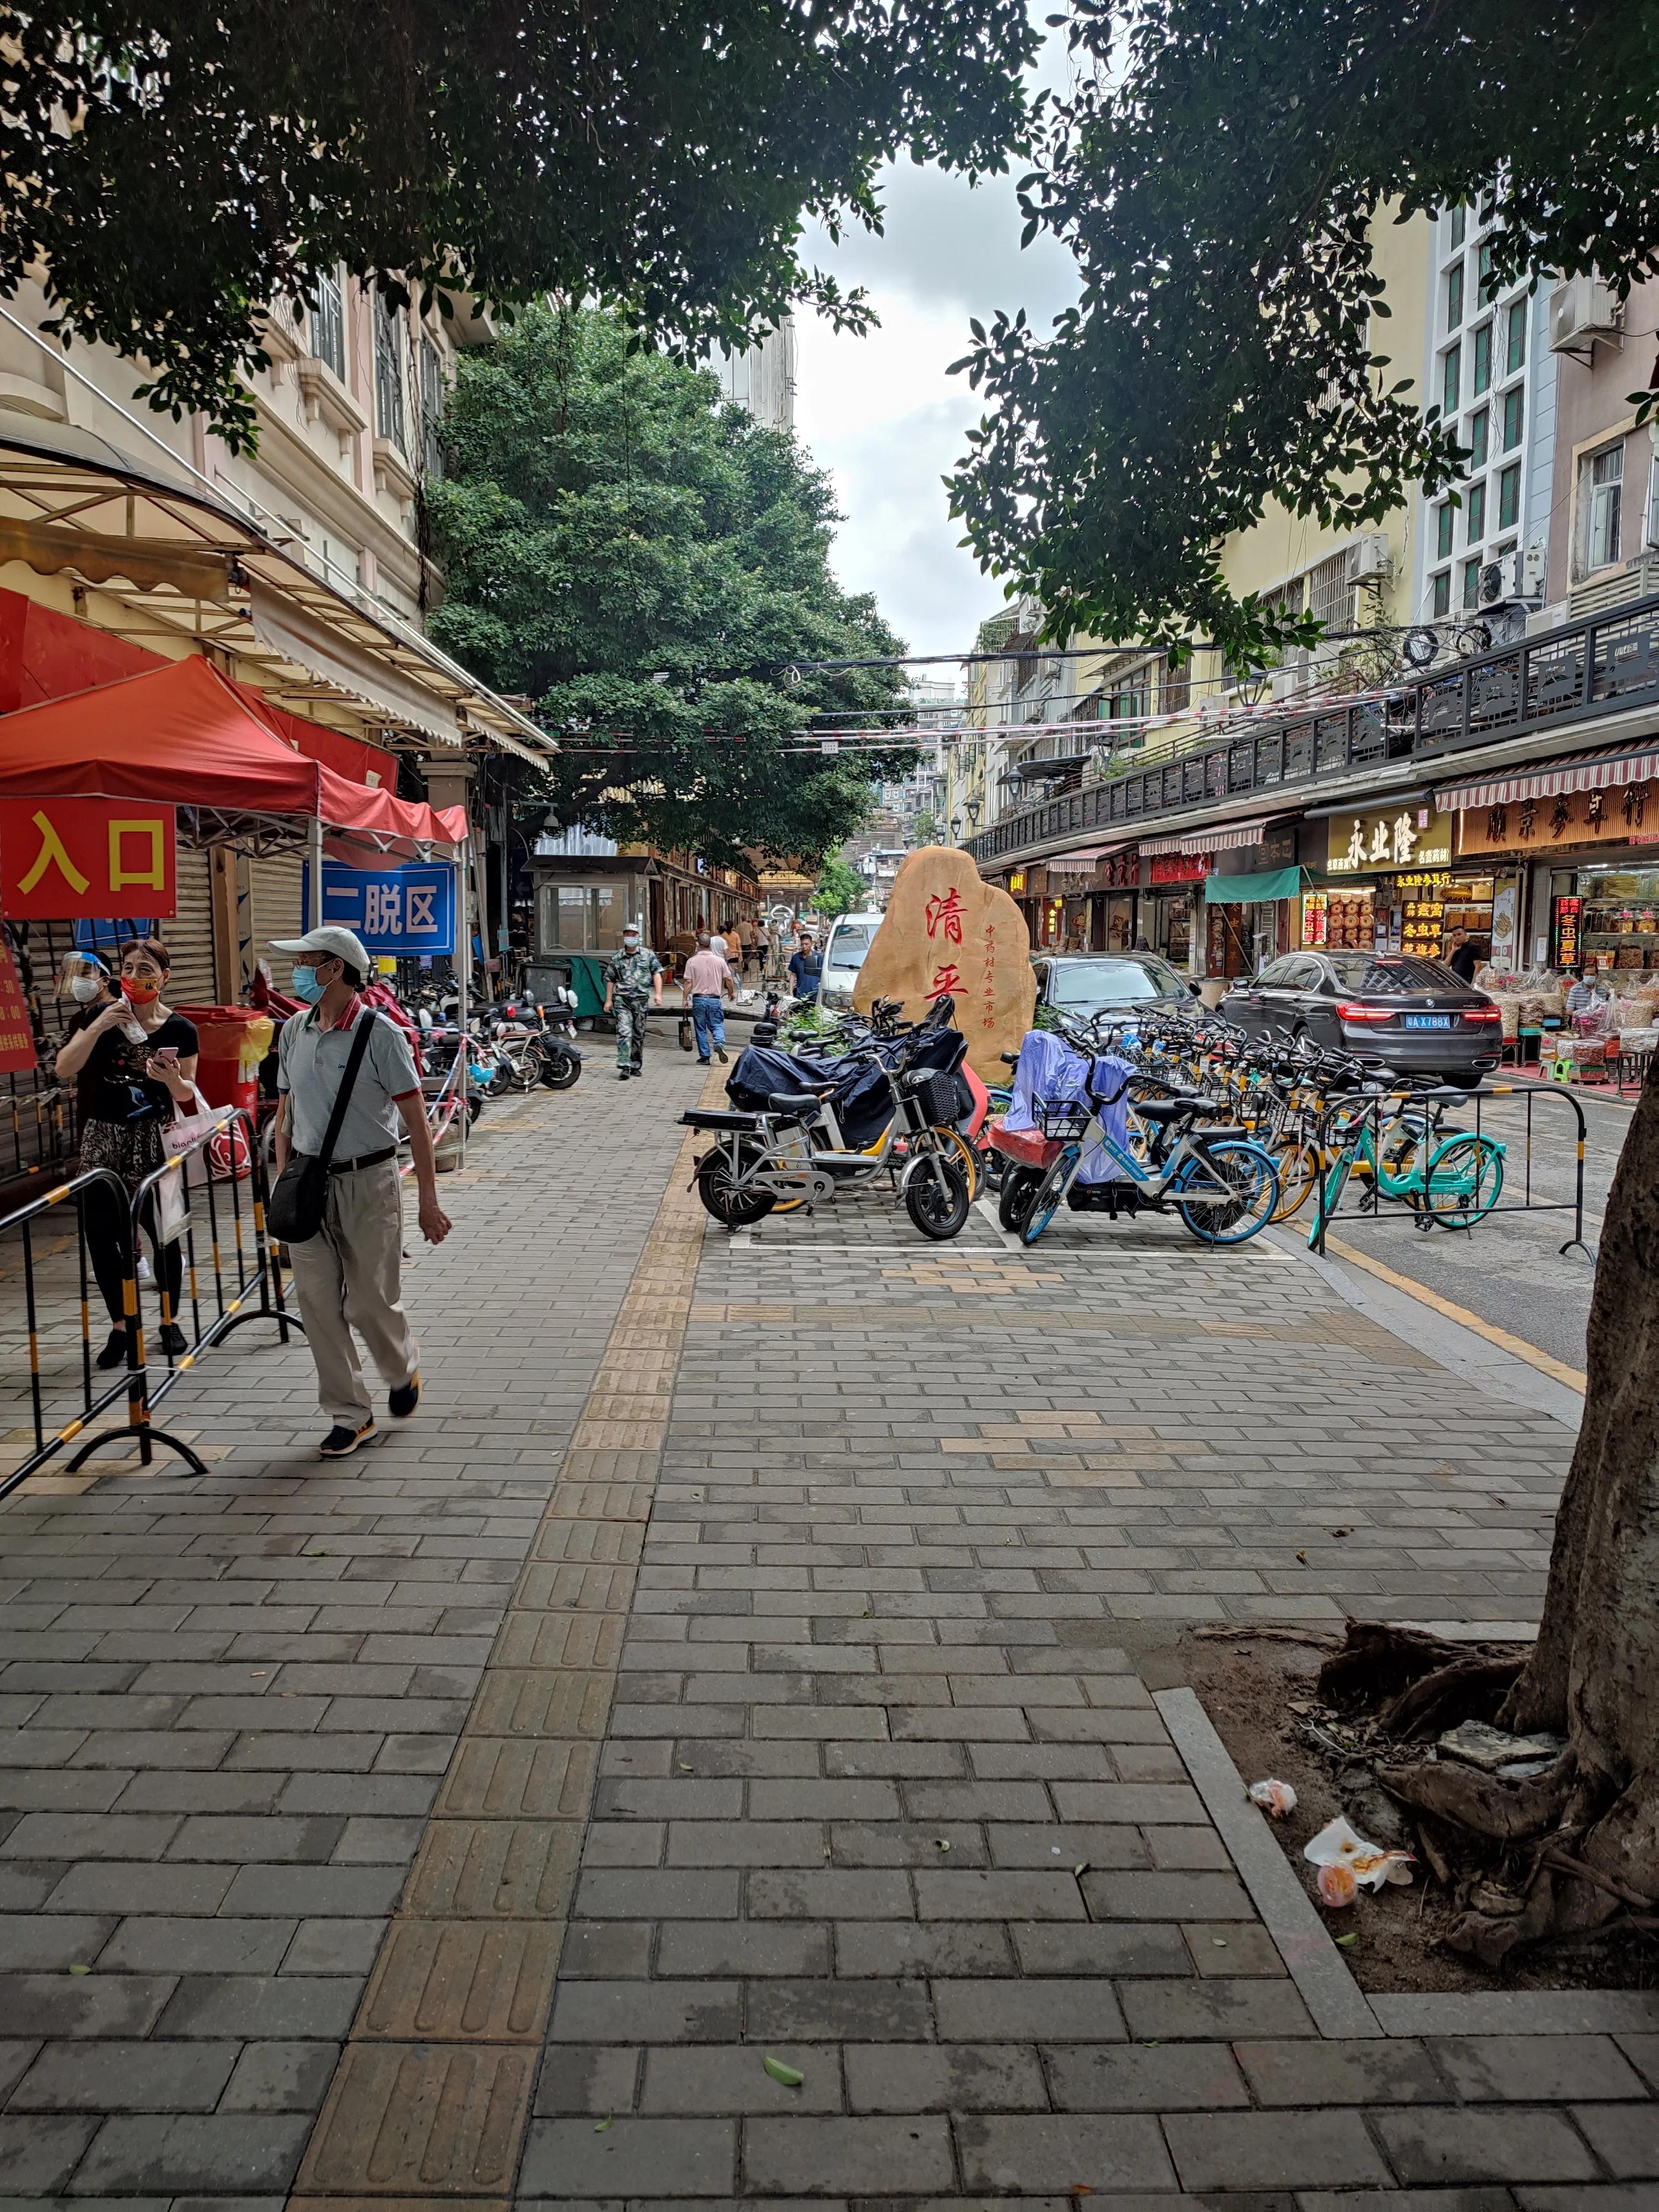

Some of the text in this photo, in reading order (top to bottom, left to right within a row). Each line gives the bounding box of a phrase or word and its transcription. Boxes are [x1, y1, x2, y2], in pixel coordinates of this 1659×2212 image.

[17, 810, 165, 895] 入口
[1348, 811, 1417, 869] 永业隆
[1418, 848, 1447, 864] 名贵药材
[323, 884, 439, 935] 二脱区
[1403, 922, 1442, 938] 冬虫草
[924, 887, 969, 1001] 清平
[1560, 914, 1577, 965] 冬虫夏草
[982, 925, 995, 1029] 中药材专业市场
